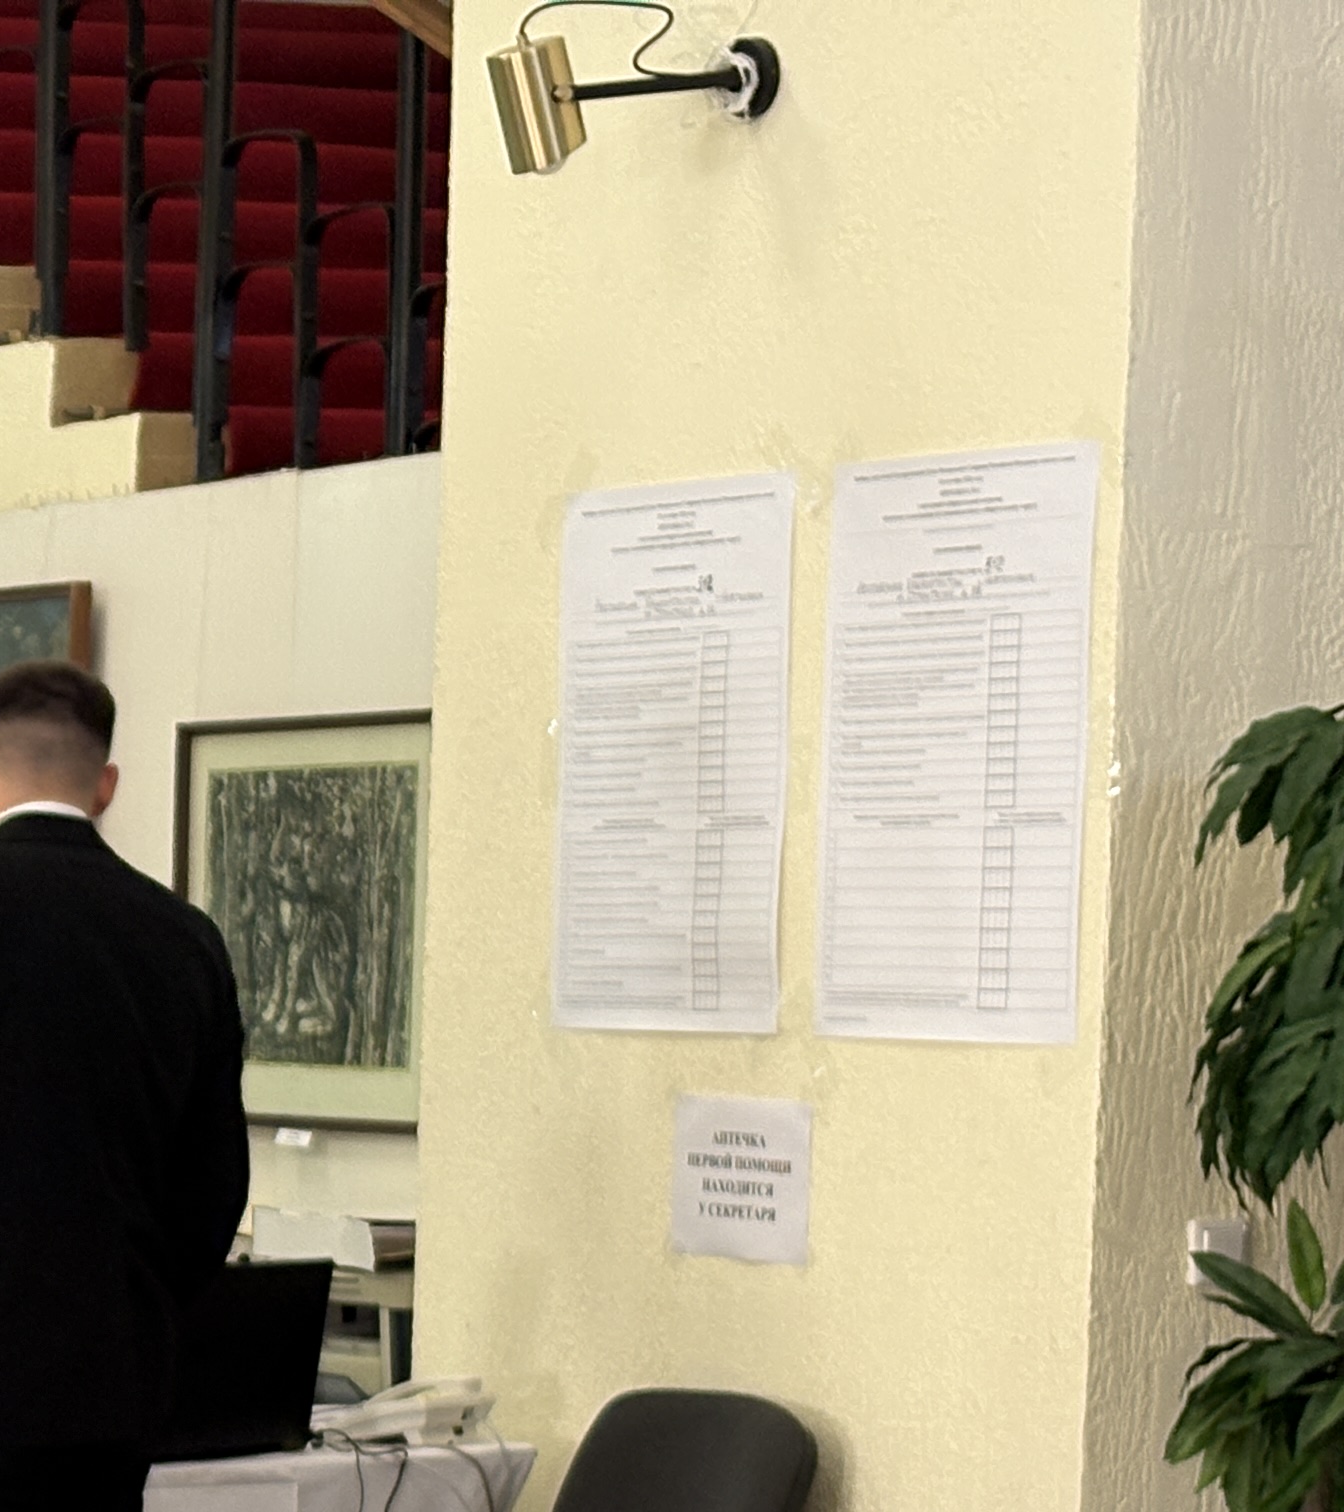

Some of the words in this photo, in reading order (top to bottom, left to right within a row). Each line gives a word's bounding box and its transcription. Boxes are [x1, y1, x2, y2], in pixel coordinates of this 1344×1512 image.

[713, 1130, 766, 1149] АПТЕЧКА
[687, 1152, 732, 1170] ПЕРВОЙ
[735, 1155, 792, 1176] ПОМОЩИ
[702, 1177, 774, 1197] НАХОДИТСЯ
[698, 1201, 705, 1216] У
[708, 1202, 776, 1222] СЕКРЕТАРЯ
